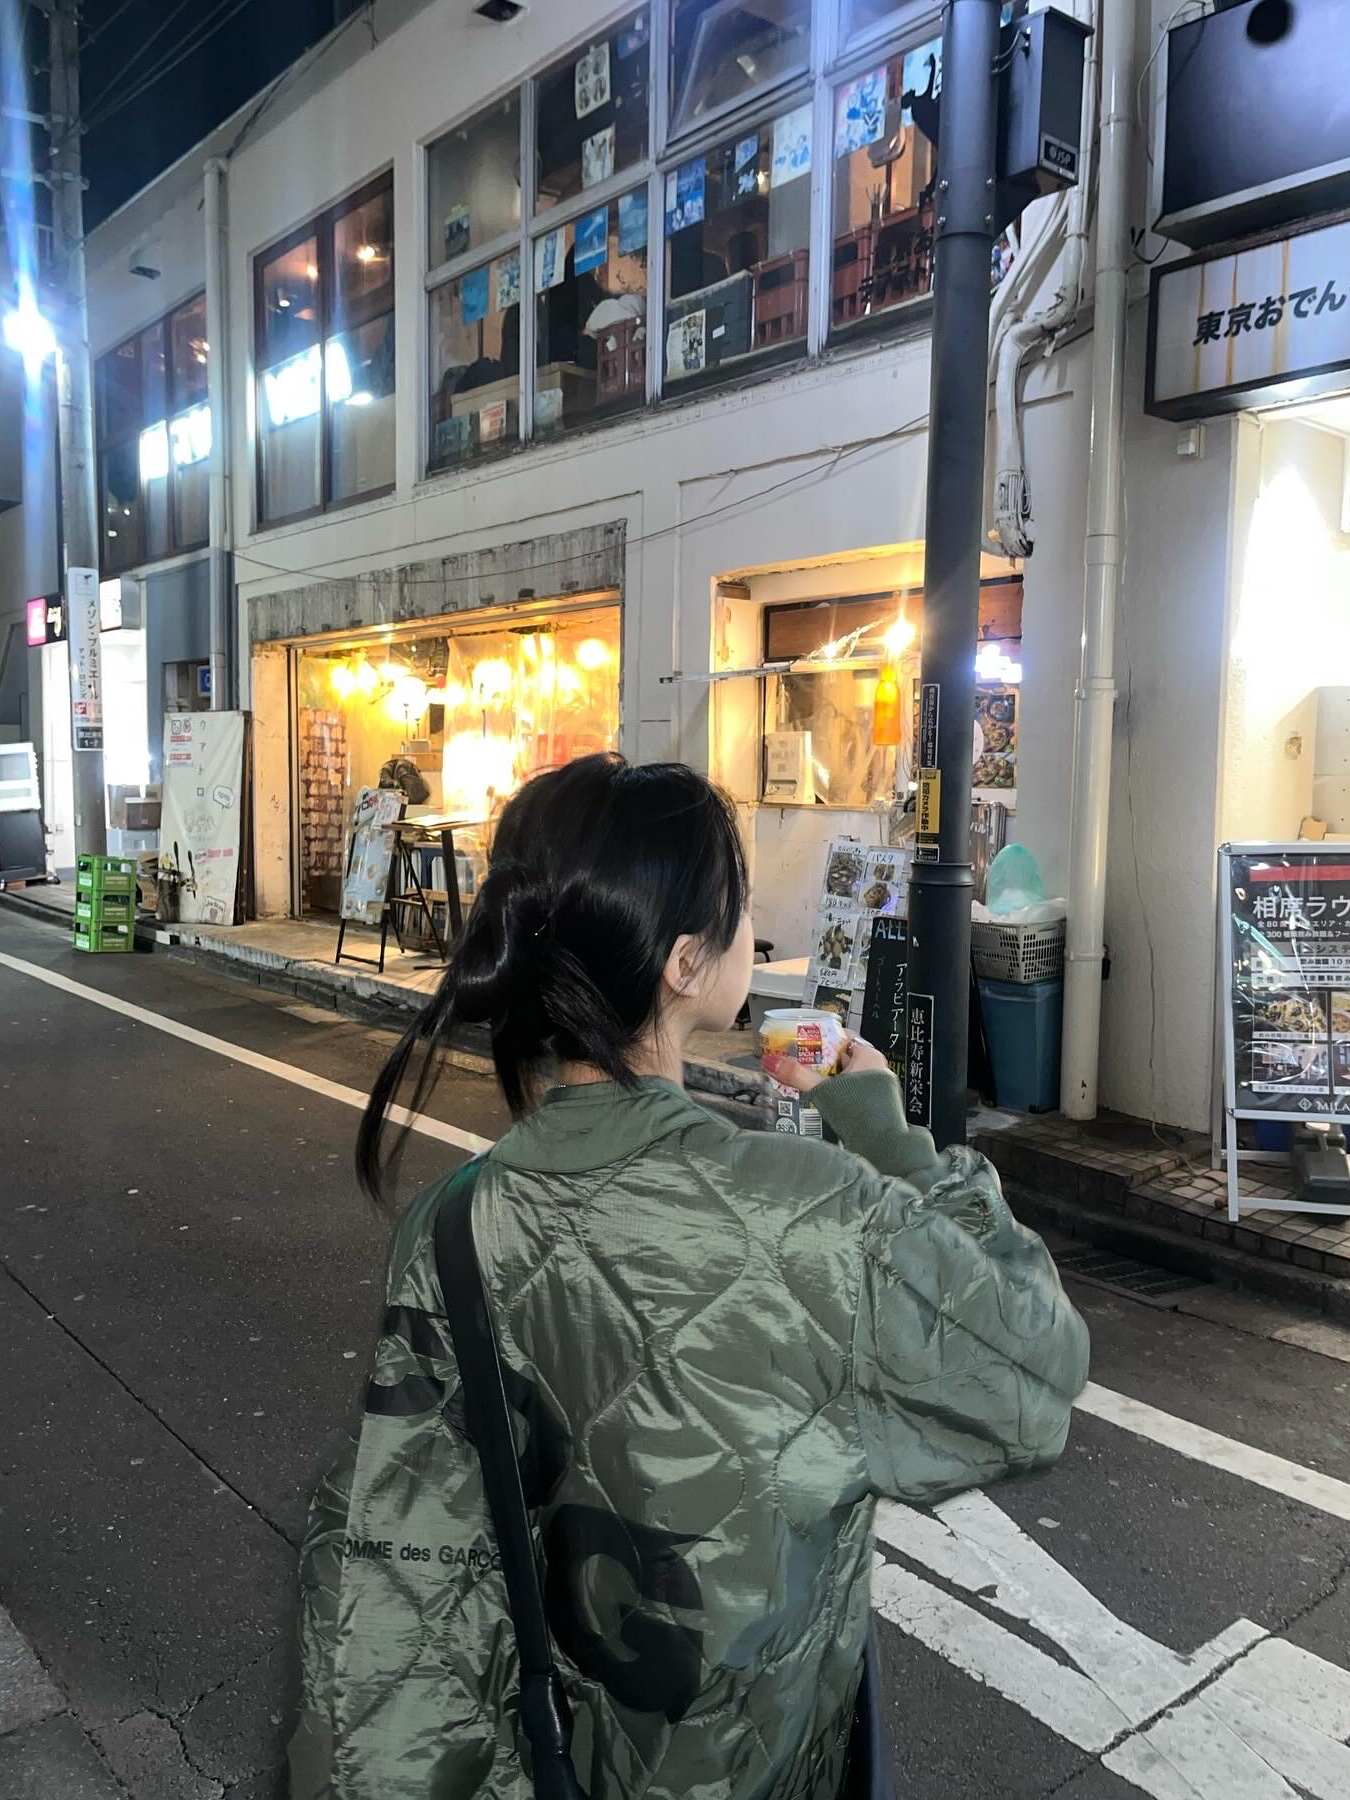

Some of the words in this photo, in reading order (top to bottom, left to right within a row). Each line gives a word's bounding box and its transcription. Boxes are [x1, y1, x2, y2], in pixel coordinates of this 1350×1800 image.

[1193, 280, 1347, 346] 東京おでん
[909, 1007, 925, 1115] 恵比寿新栄会
[344, 1537, 393, 1560] OMME
[400, 1542, 431, 1562] des
